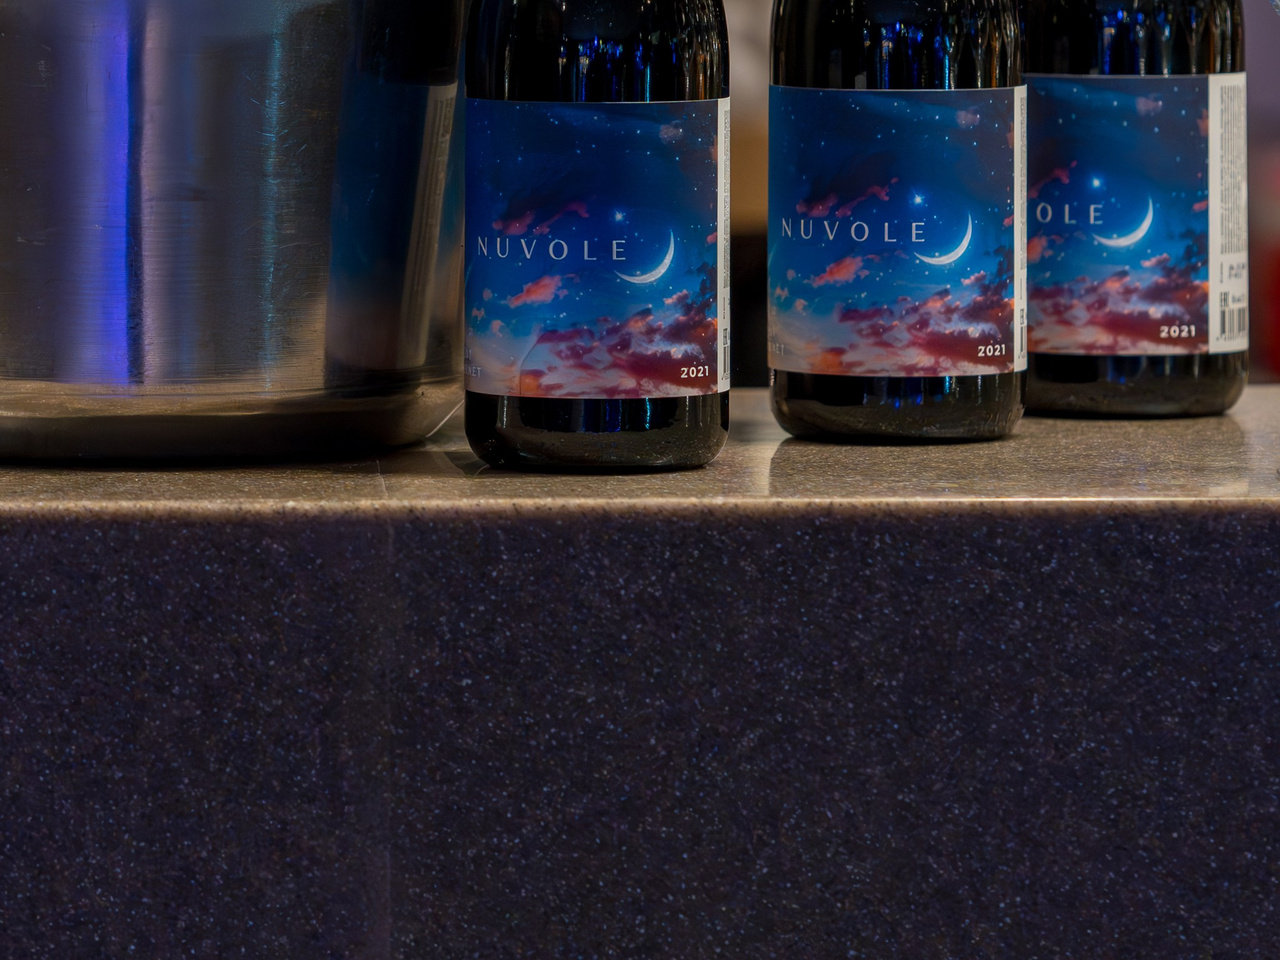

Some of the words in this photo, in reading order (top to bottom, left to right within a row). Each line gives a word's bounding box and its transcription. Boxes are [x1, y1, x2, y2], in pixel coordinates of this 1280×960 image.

[1036, 202, 1104, 225] OLE
[781, 217, 926, 242] NUVOLE
[477, 235, 626, 261] NUVOLE
[1160, 324, 1196, 338] 2021
[977, 343, 1006, 357] 2021
[680, 365, 709, 379] 2021
